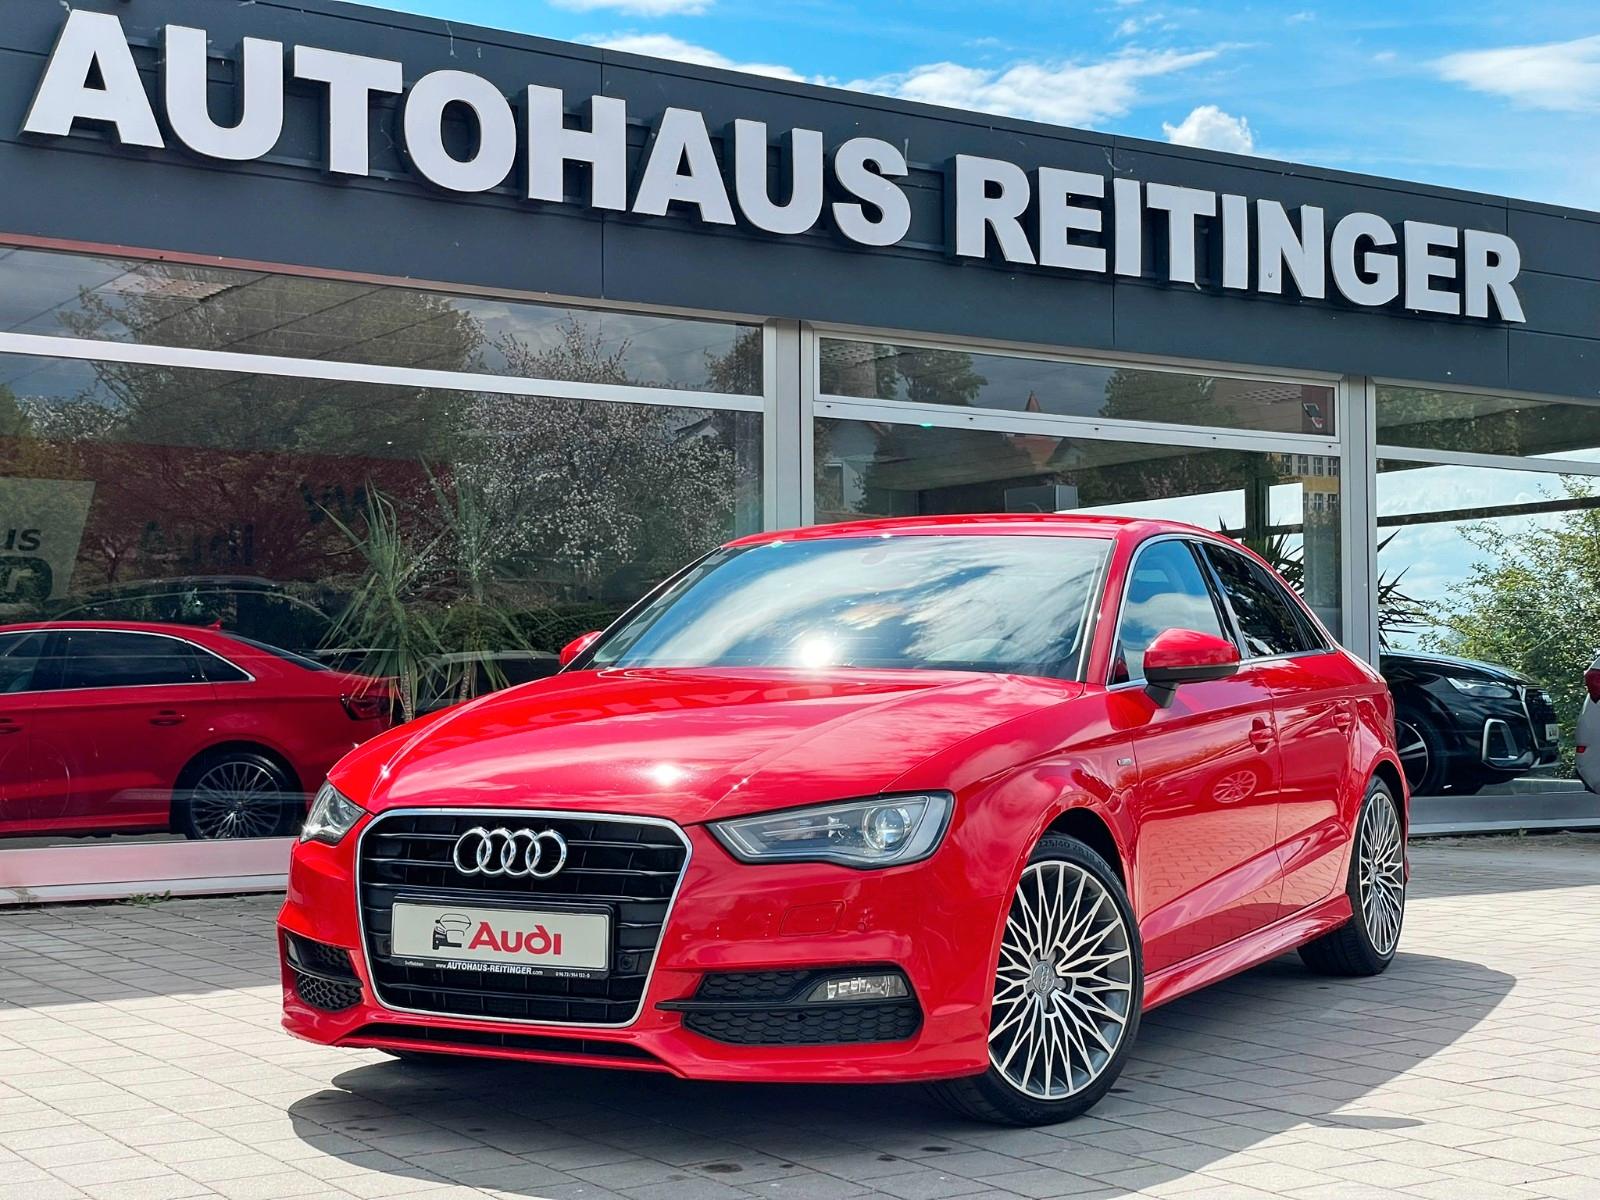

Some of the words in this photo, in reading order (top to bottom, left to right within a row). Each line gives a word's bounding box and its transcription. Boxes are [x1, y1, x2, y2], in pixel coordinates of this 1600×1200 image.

[22, 9, 912, 248] AUTOHAUS
[955, 153, 1526, 324] REITINGER
[468, 921, 562, 955] Audi
